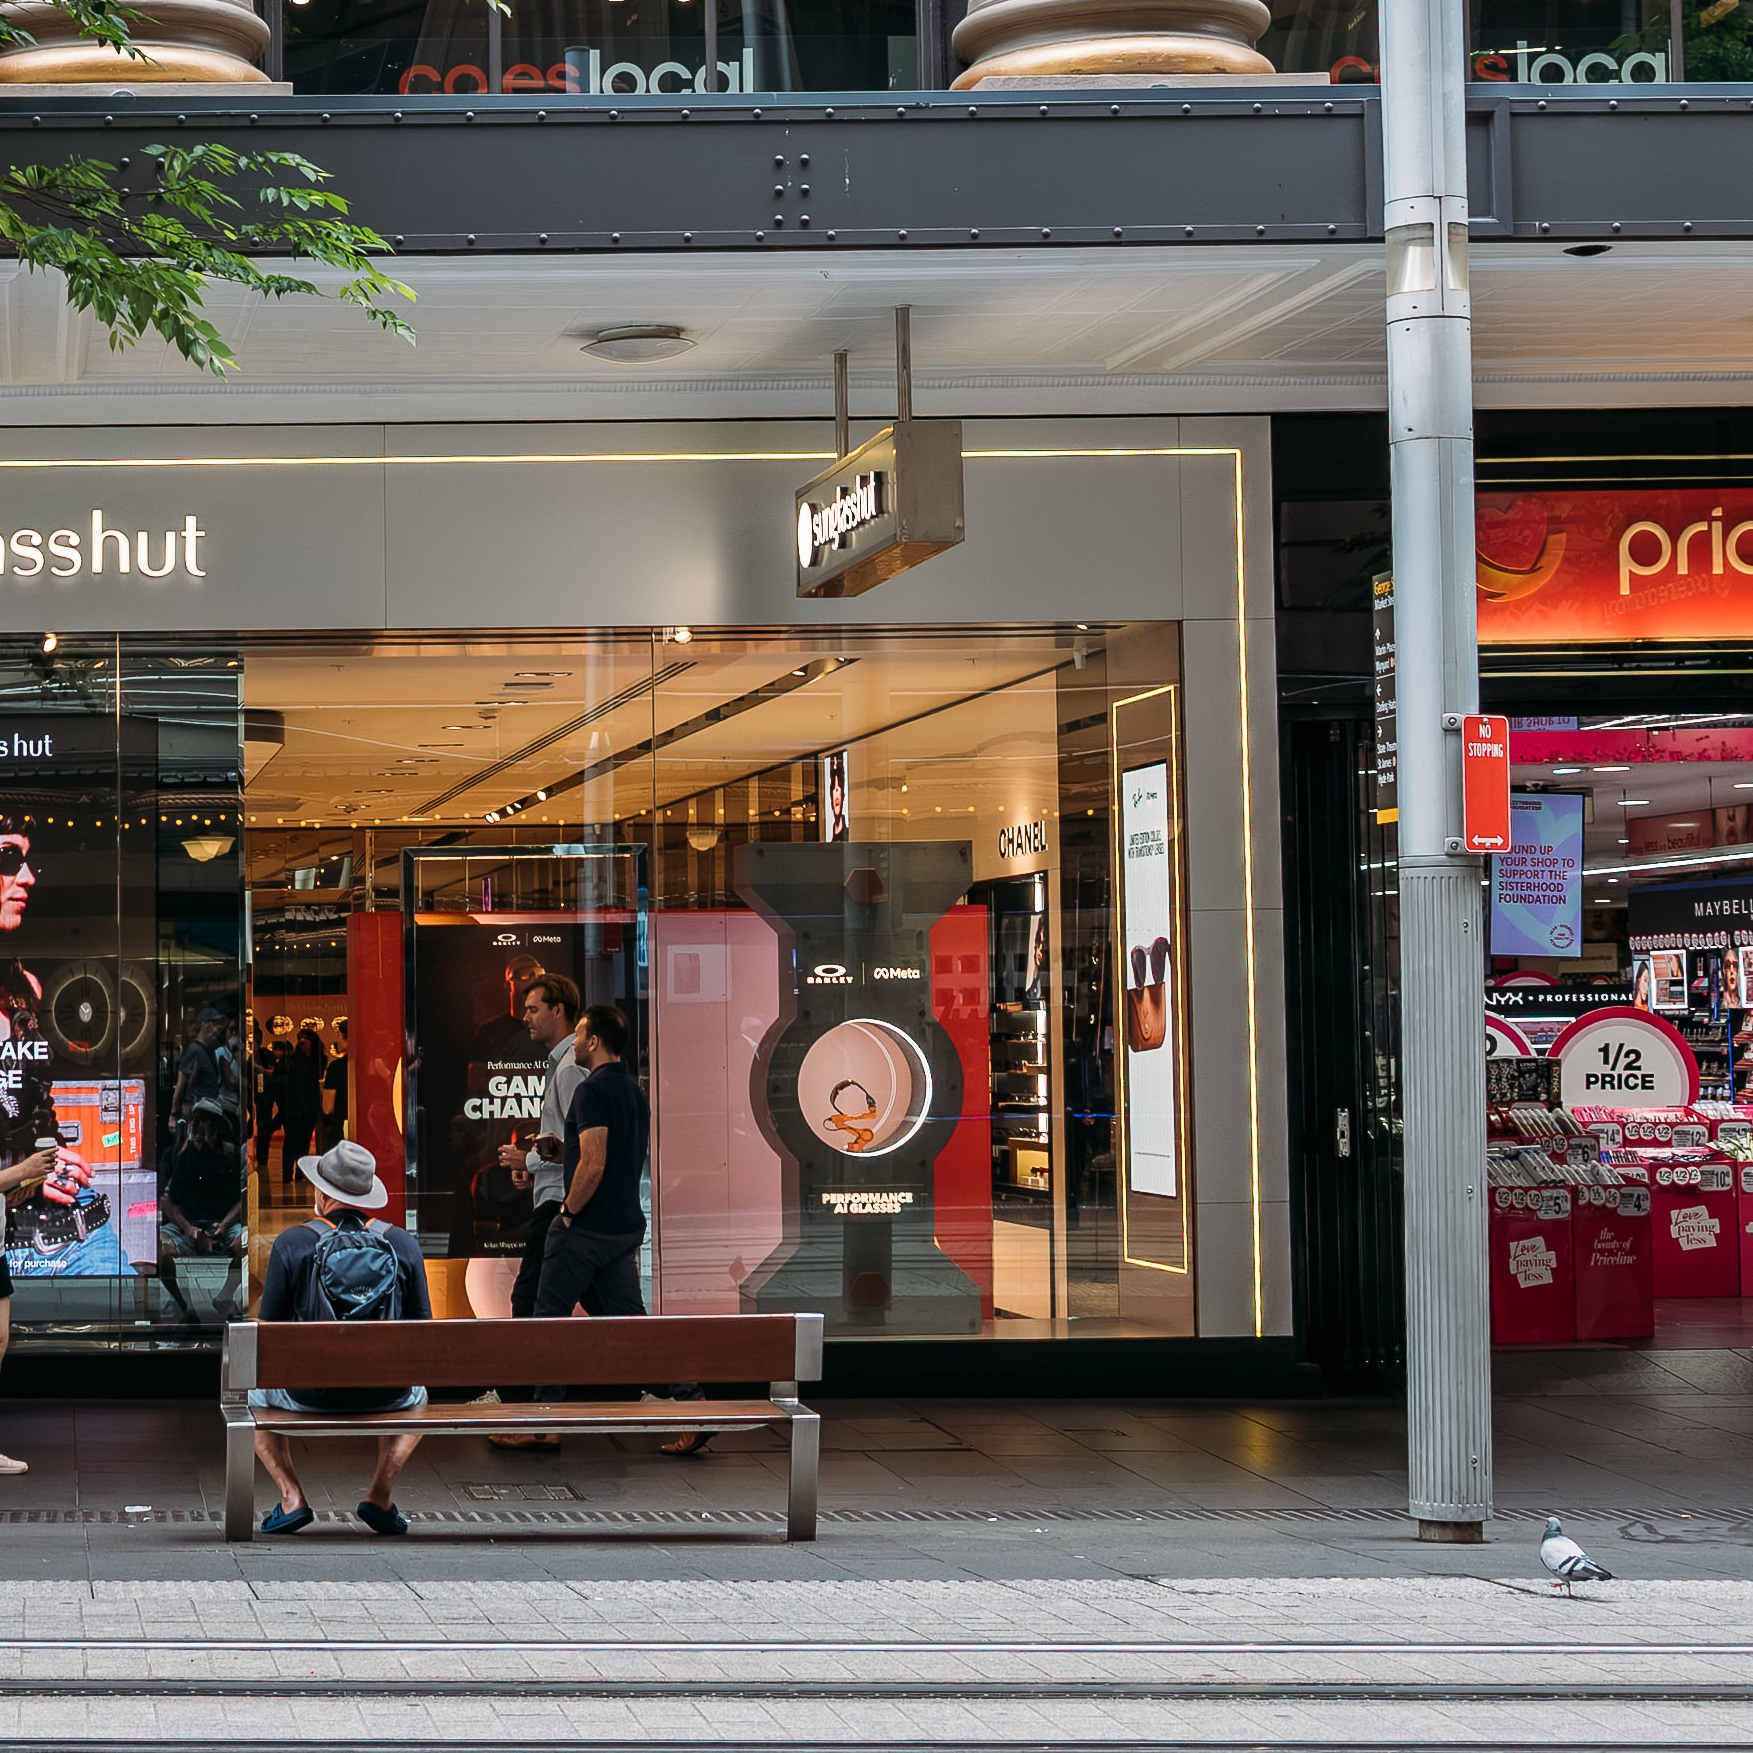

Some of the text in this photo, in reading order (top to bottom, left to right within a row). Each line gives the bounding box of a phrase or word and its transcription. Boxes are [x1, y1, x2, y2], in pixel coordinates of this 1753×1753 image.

[398, 47, 755, 94] coes local
[812, 469, 877, 551] sunglasshut
[1479, 724, 1492, 739] NO
[13, 732, 53, 757] hut
[1468, 742, 1504, 758] STOPPING
[998, 820, 1047, 860] CHANEL
[1540, 846, 1554, 855] UP
[1499, 857, 1575, 869] YOUR SHOP TO
[1499, 869, 1568, 881] SUPPORT THE
[1499, 881, 1564, 892] SISTERHOOD
[1499, 893, 1567, 905] FOUNDATION
[807, 968, 921, 984] OAKLEY Meta
[1538, 993, 1634, 1002] PROFESSIONAL
[1598, 1042, 1642, 1072] 1/2
[487, 1060, 533, 1070] Performance
[488, 1075, 546, 1097] GAM
[1585, 1073, 1655, 1091] PRICE
[822, 1192, 914, 1205] PERFORMANCE
[833, 1202, 902, 1214] AI GLASSES
[1674, 1209, 1704, 1227] Love
[1600, 1227, 1614, 1240] the
[1677, 1222, 1717, 1237] paying
[1593, 1237, 1634, 1253] beauty of
[1686, 1233, 1707, 1246] less
[1512, 1241, 1541, 1262] Love
[1590, 1251, 1636, 1267] Priceline
[23, 1259, 68, 1271] purchase
[1515, 1255, 1552, 1272] paying
[1523, 1269, 1544, 1283] less
